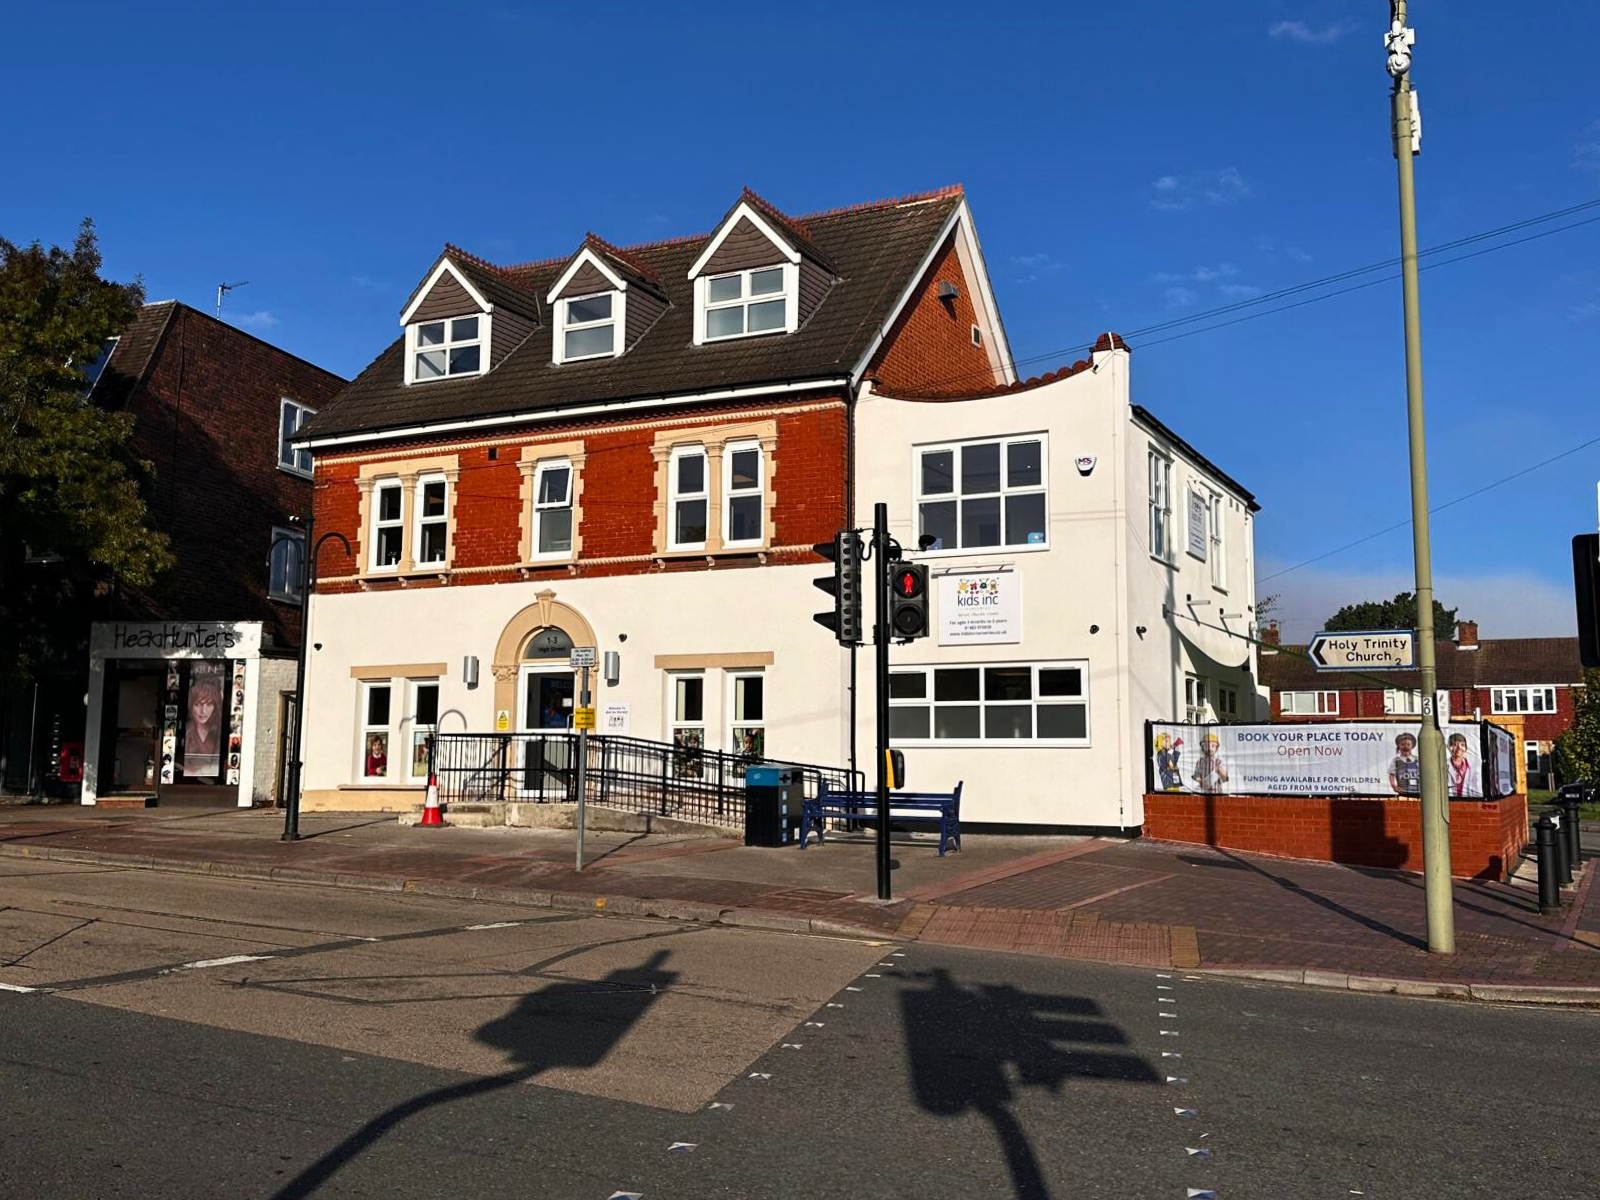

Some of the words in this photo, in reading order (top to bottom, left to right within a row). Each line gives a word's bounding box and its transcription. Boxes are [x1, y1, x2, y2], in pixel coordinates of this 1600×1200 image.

[957, 594, 980, 607] kids
[982, 594, 999, 605] inc
[114, 625, 236, 650] HeadHunters
[547, 636, 558, 644] 1-3
[1329, 640, 1358, 651] Holy
[1364, 638, 1407, 649] Trinity
[1346, 652, 1392, 662] Church
[1237, 733, 1270, 742] BOOK
[1272, 733, 1304, 741] YOUR
[1306, 732, 1341, 741] PLACE
[1344, 732, 1384, 741] TODAY
[1277, 745, 1311, 758] Open
[1314, 745, 1343, 756] Now
[1243, 775, 1279, 783] FUNDING
[1320, 784, 1356, 792] MONTHS
